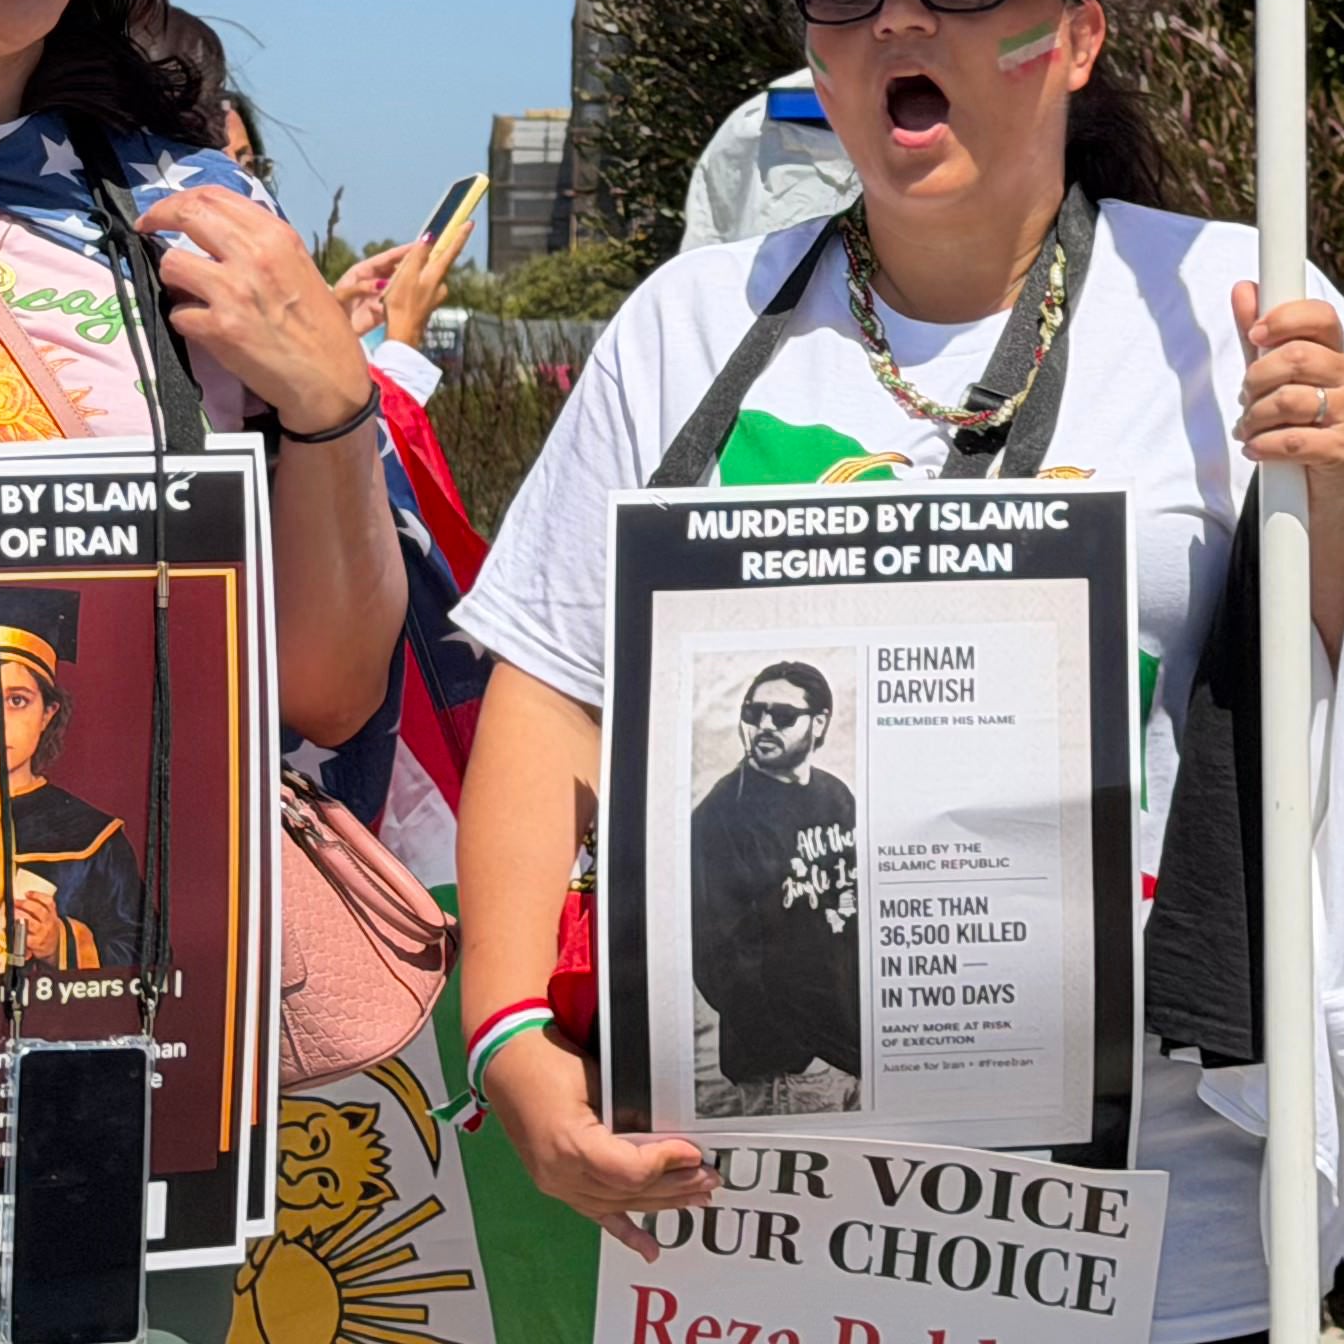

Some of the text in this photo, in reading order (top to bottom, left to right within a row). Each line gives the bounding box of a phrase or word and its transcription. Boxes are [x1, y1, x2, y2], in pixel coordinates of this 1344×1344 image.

[0, 483, 46, 514] BY
[54, 481, 191, 513] ISLAMC
[687, 500, 1069, 540] MURDERED BY ISLAMIC
[0, 527, 47, 557] OF
[55, 525, 138, 557] IRAN
[741, 543, 1013, 580] REGIME OF IRAN
[877, 646, 975, 672] BEHNAM
[877, 677, 975, 703] DARVISH
[876, 715, 1016, 726] REMEMBER HIS NAME
[878, 843, 982, 856] KILLED BY THE
[878, 857, 1011, 872] ISLAMIC REPUBLIC
[880, 896, 989, 918] MORE THAN
[880, 921, 1027, 949] 36,500 KILLED
[881, 956, 902, 977] IN
[908, 954, 957, 976] IRAN
[36, 977, 53, 1000] 8
[58, 978, 124, 1004] years
[881, 983, 1015, 1008] IN TWO DAYS
[881, 1020, 1012, 1033] MANY MORE AT RISK
[881, 1035, 975, 1048] OF EXECUTION
[709, 1147, 1129, 1239] UR VOICE
[642, 1206, 1117, 1316] OUR CHOICE
